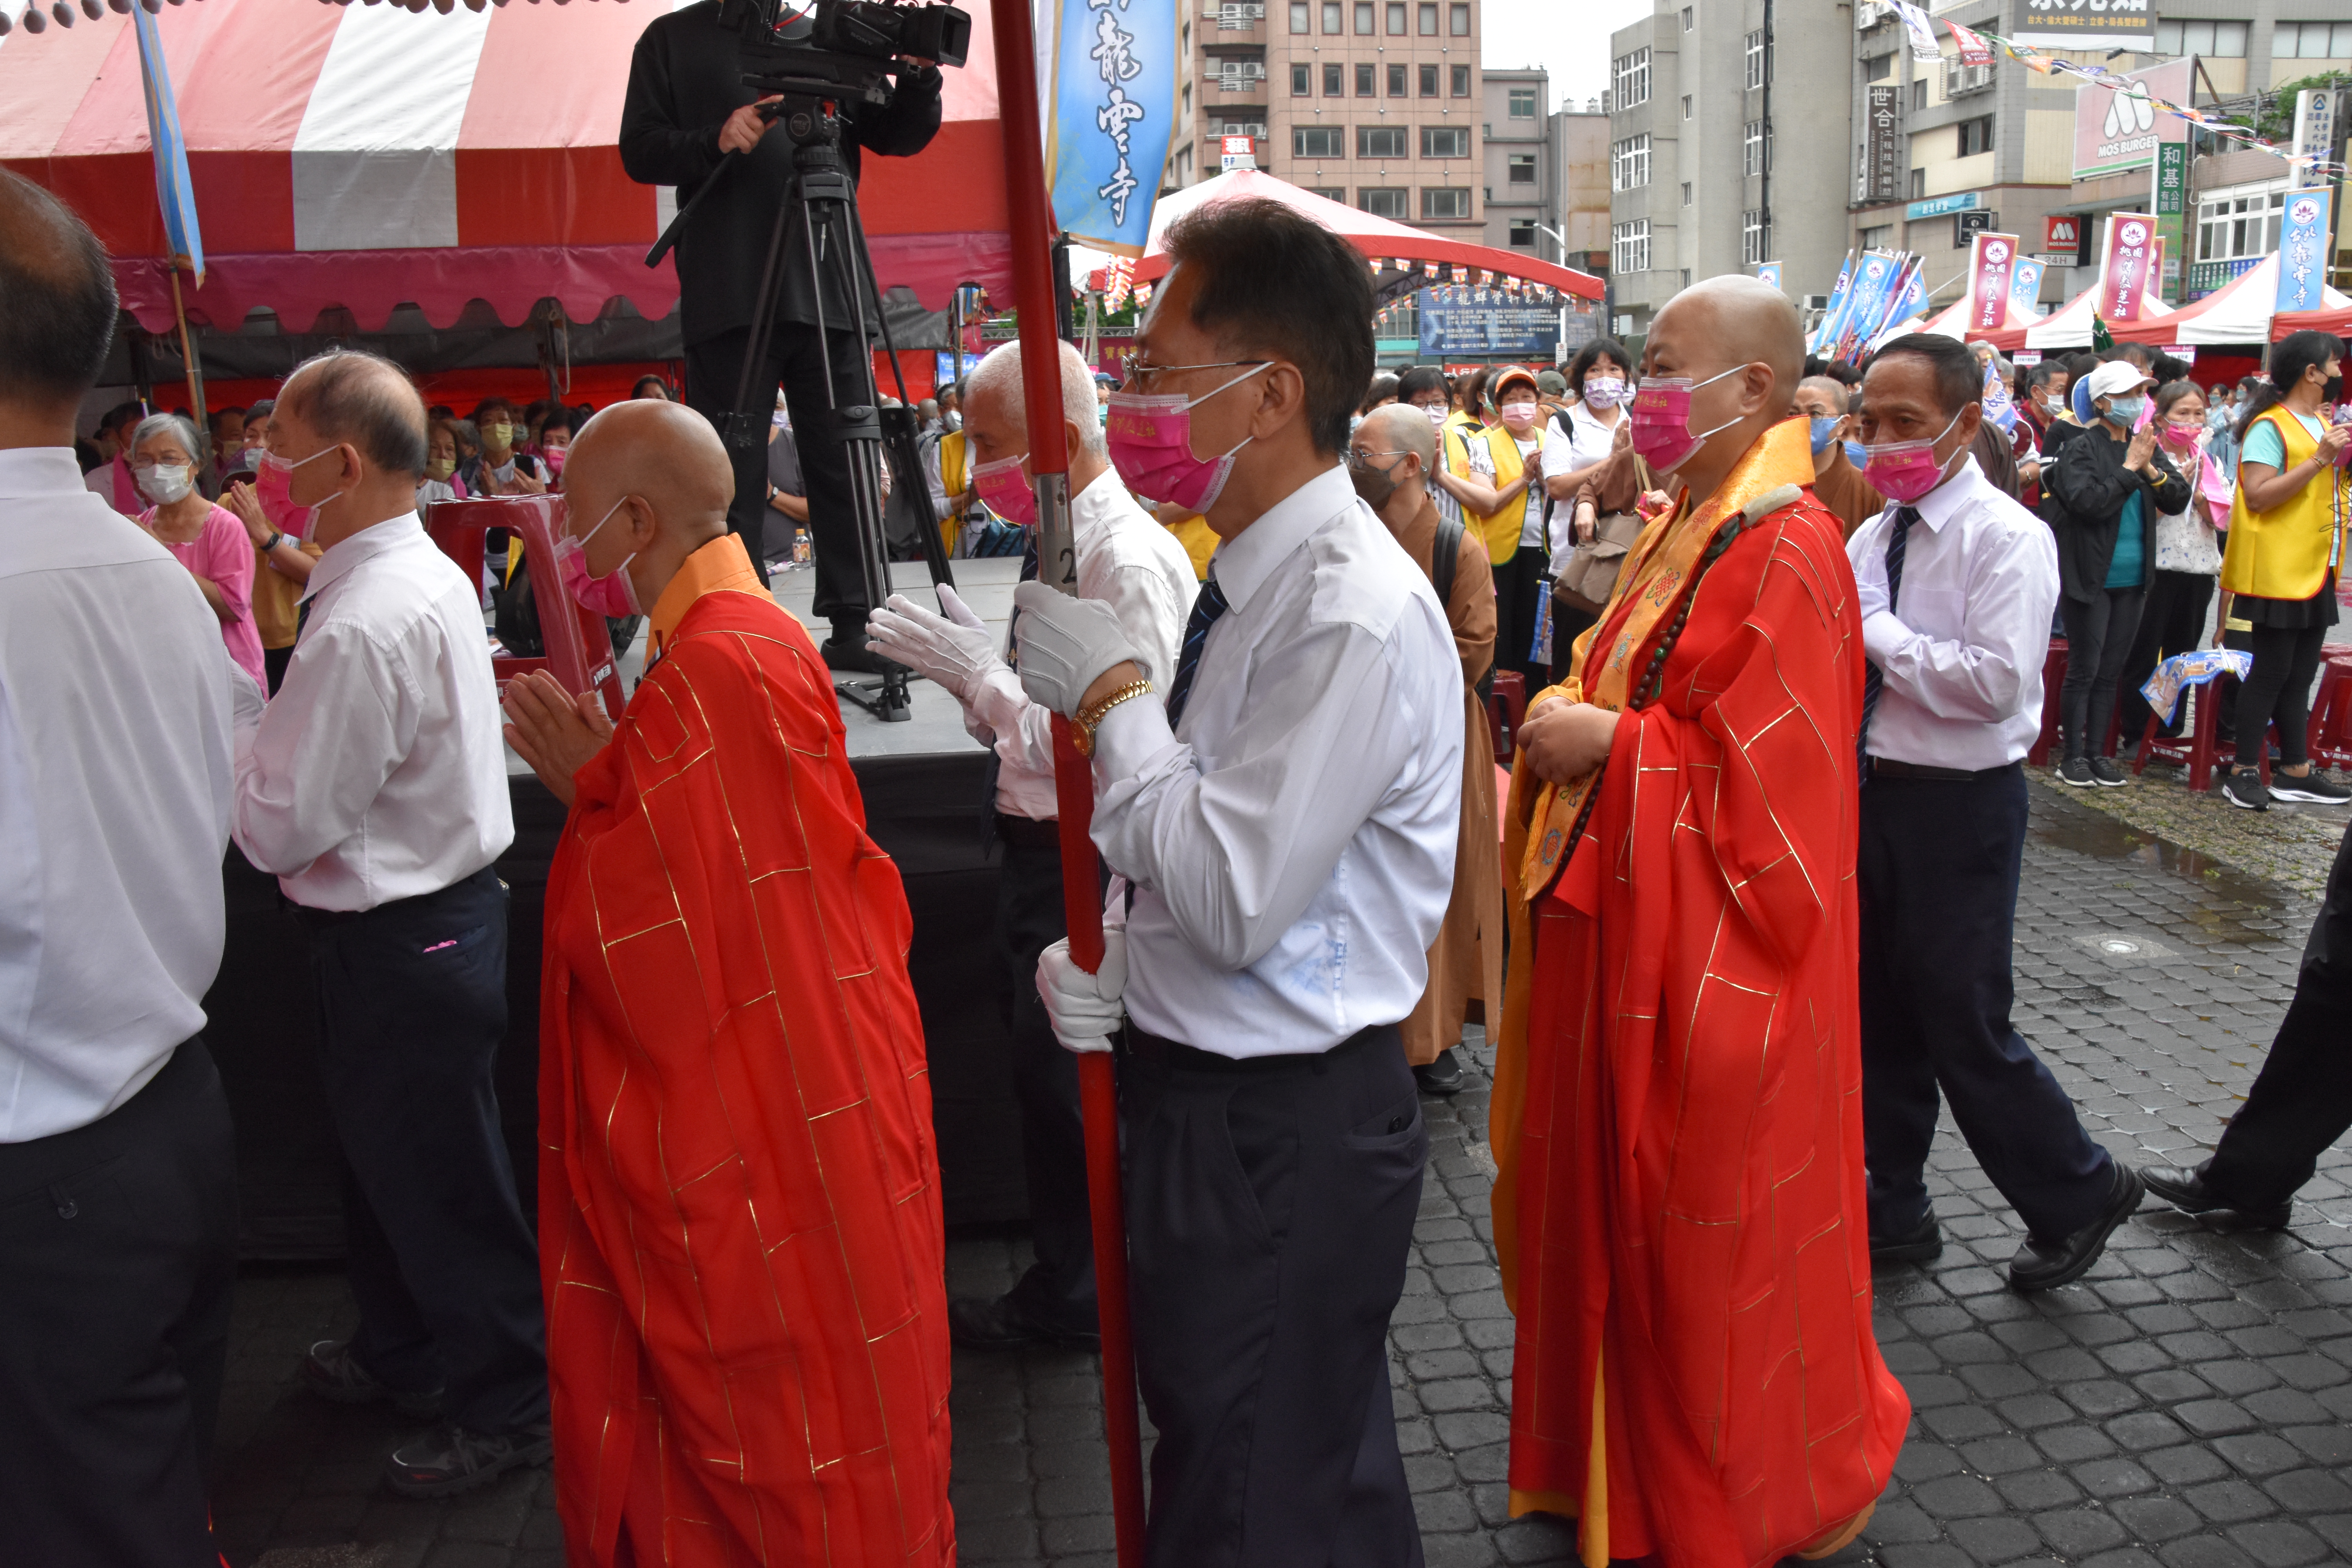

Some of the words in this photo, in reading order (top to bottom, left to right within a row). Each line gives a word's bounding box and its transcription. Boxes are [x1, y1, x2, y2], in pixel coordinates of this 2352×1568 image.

[1870, 88, 1895, 127] 世合
[2098, 142, 2120, 158] MOS
[2120, 134, 2159, 154] BURGER
[2162, 146, 2181, 188] 和基
[2044, 256, 2067, 265] 24H
